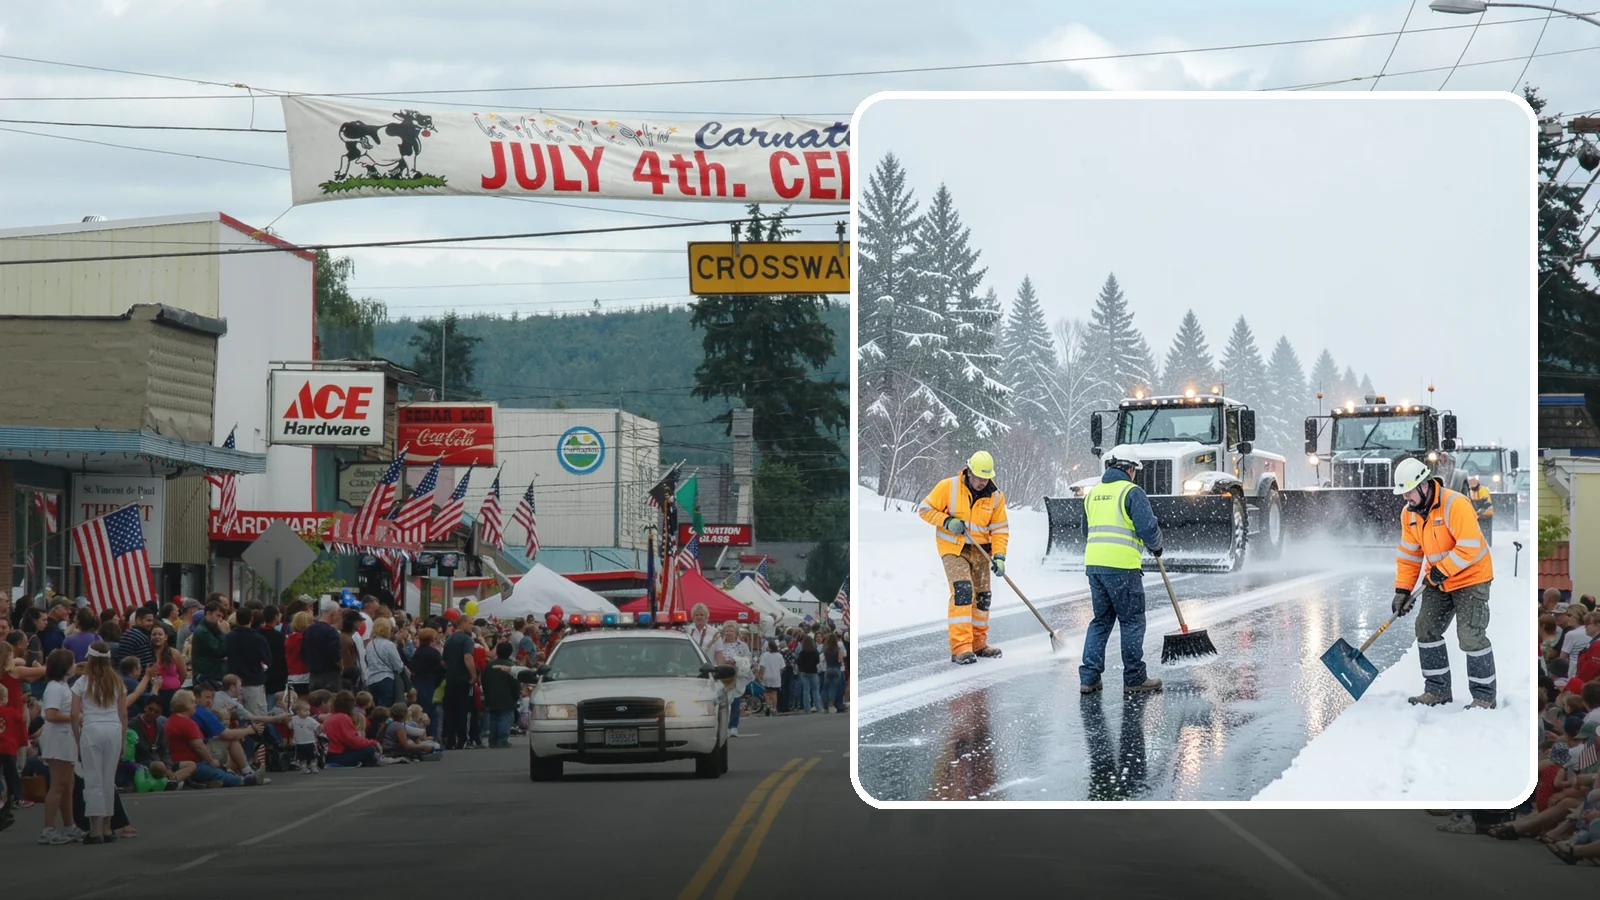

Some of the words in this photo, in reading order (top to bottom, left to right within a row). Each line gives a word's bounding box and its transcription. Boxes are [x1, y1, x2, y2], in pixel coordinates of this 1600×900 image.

[694, 121, 850, 149] Carnat
[481, 141, 605, 193] JULY
[633, 150, 746, 198] 4th.
[697, 254, 850, 280] CROSSWA
[283, 380, 373, 420] ACE
[406, 409, 452, 422] CEDAR
[283, 421, 370, 436] Hardware
[416, 428, 476, 447] Coca-Cola
[353, 467, 384, 481] Simpl
[83, 484, 93, 494] St.
[96, 485, 124, 495] Vincent
[126, 486, 136, 495] de
[138, 486, 155, 495] Paul
[81, 503, 153, 522] THT
[688, 526, 742, 535] CRNATION
[699, 535, 730, 543] GLASS
